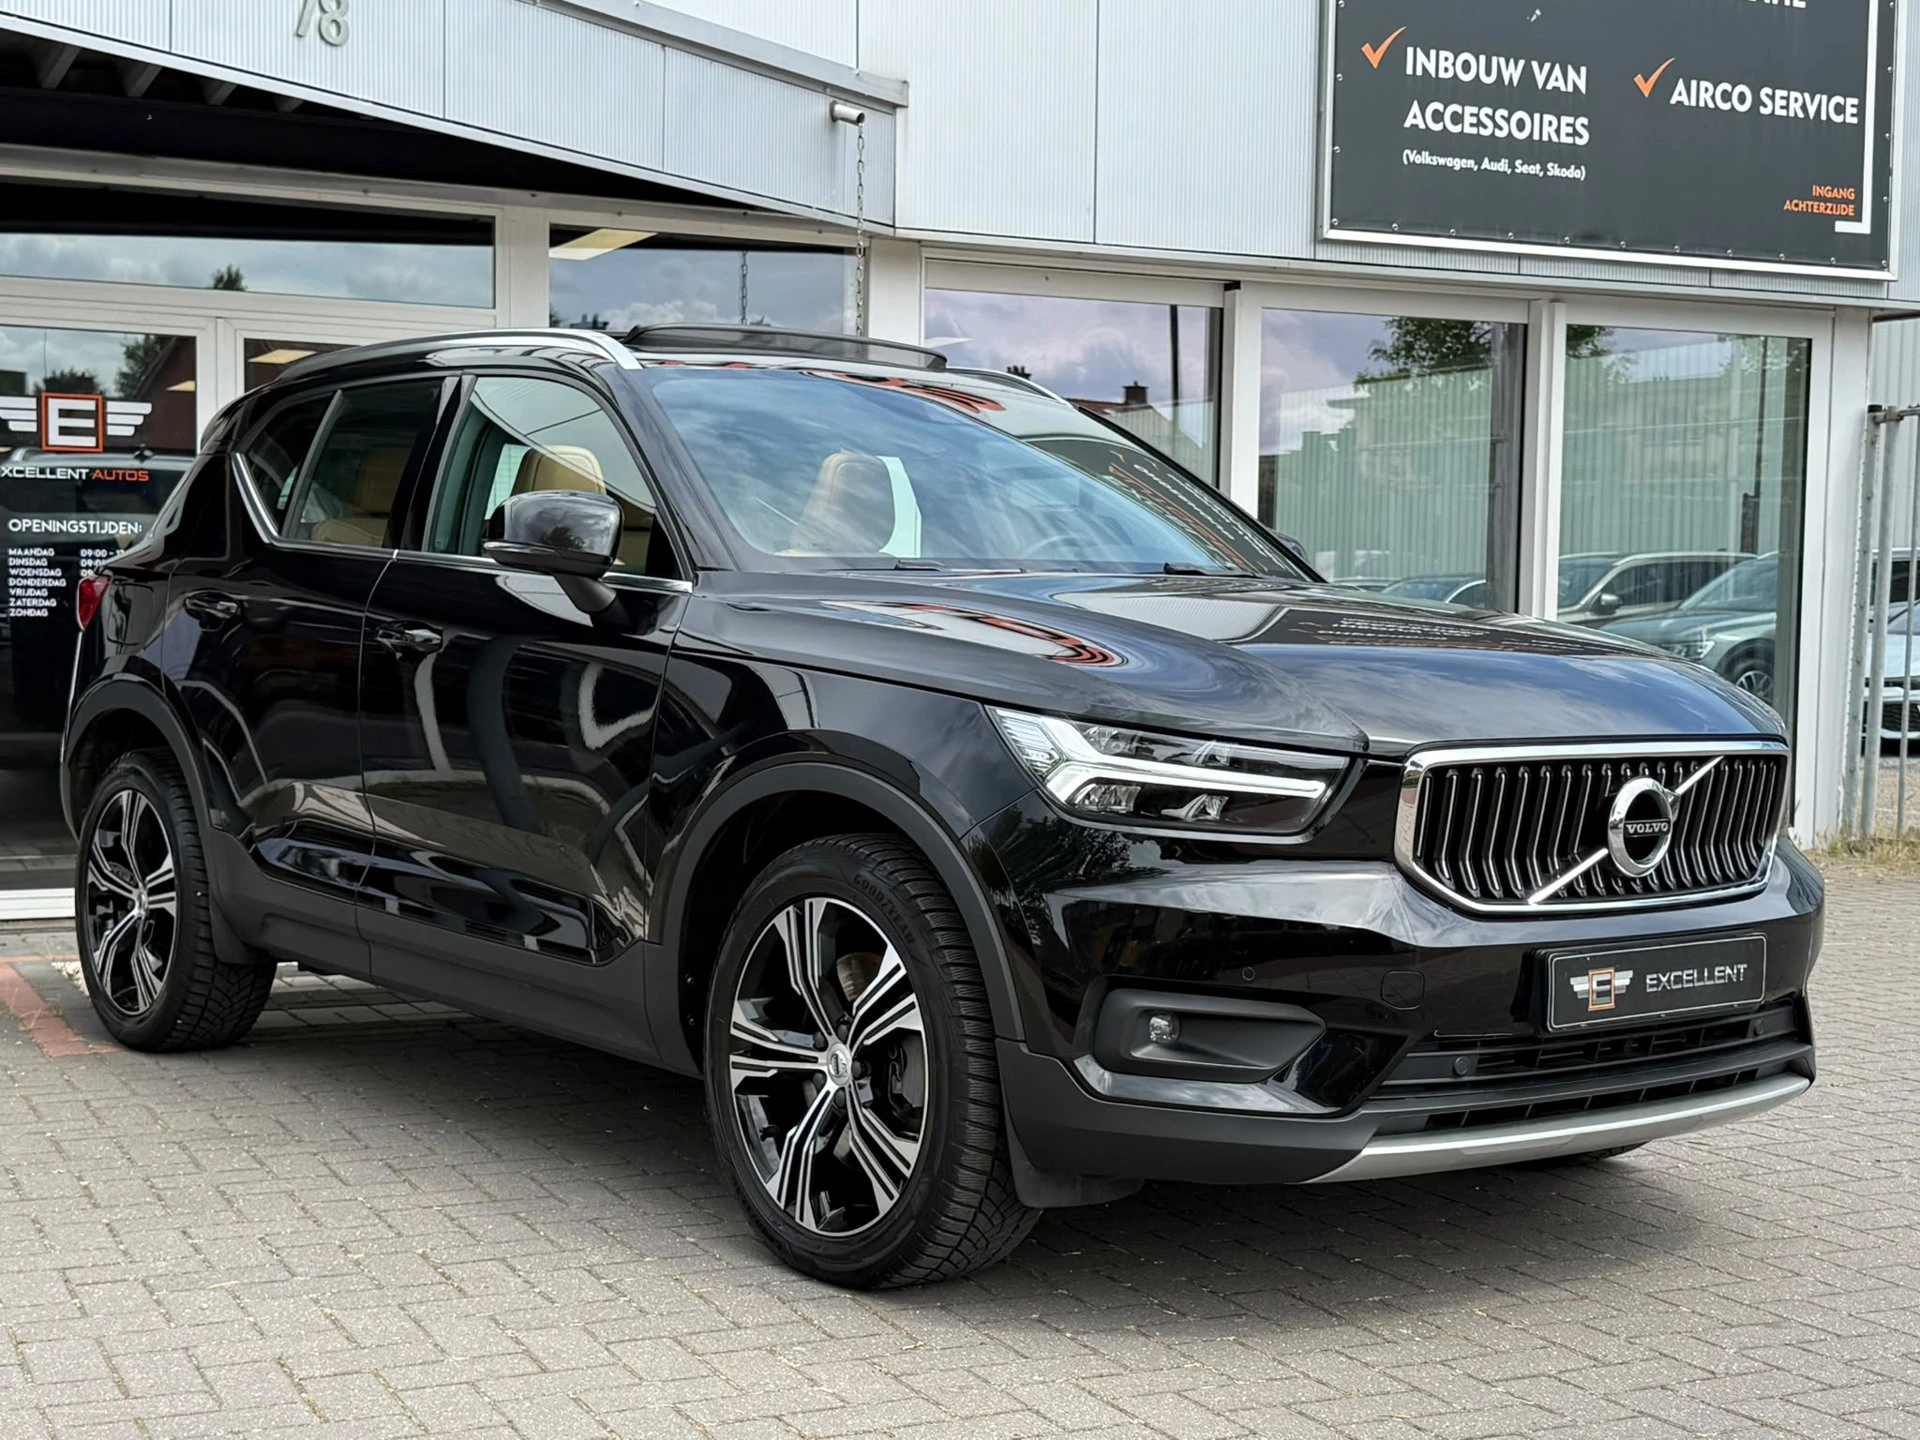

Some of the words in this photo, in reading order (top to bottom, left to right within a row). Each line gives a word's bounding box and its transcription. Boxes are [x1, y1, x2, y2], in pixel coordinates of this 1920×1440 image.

[1405, 46, 1525, 88] INBOUW
[1531, 60, 1587, 95] VAN
[1669, 78, 1752, 112] AIRCO
[1759, 87, 1859, 124] SERVICE
[1403, 100, 1590, 146] ACCESSOIRES
[1402, 149, 1478, 171] (Volkswagen,
[1480, 157, 1512, 174] Audi,
[1514, 160, 1544, 177] Seat,
[1546, 162, 1586, 181] Skoda)
[1812, 185, 1855, 200] INGANG
[1784, 200, 1855, 216] ACHTERZIJDE
[1, 466, 89, 480] XCELLENT
[92, 469, 149, 481] AUTOS
[8, 519, 142, 534] OPENINGSTIJDEN:
[9, 548, 55, 557] MAANDAG
[9, 558, 48, 567] DINSDAG
[9, 568, 62, 577] WOENSDAG
[9, 578, 66, 587] DONDERDAG
[9, 588, 48, 597] VRIJDAG
[9, 598, 57, 607] ZATERDAG
[9, 608, 48, 617] ZONDAG
[1625, 822, 1669, 834] VOLVO
[1646, 963, 1748, 992] EXCELLENT
